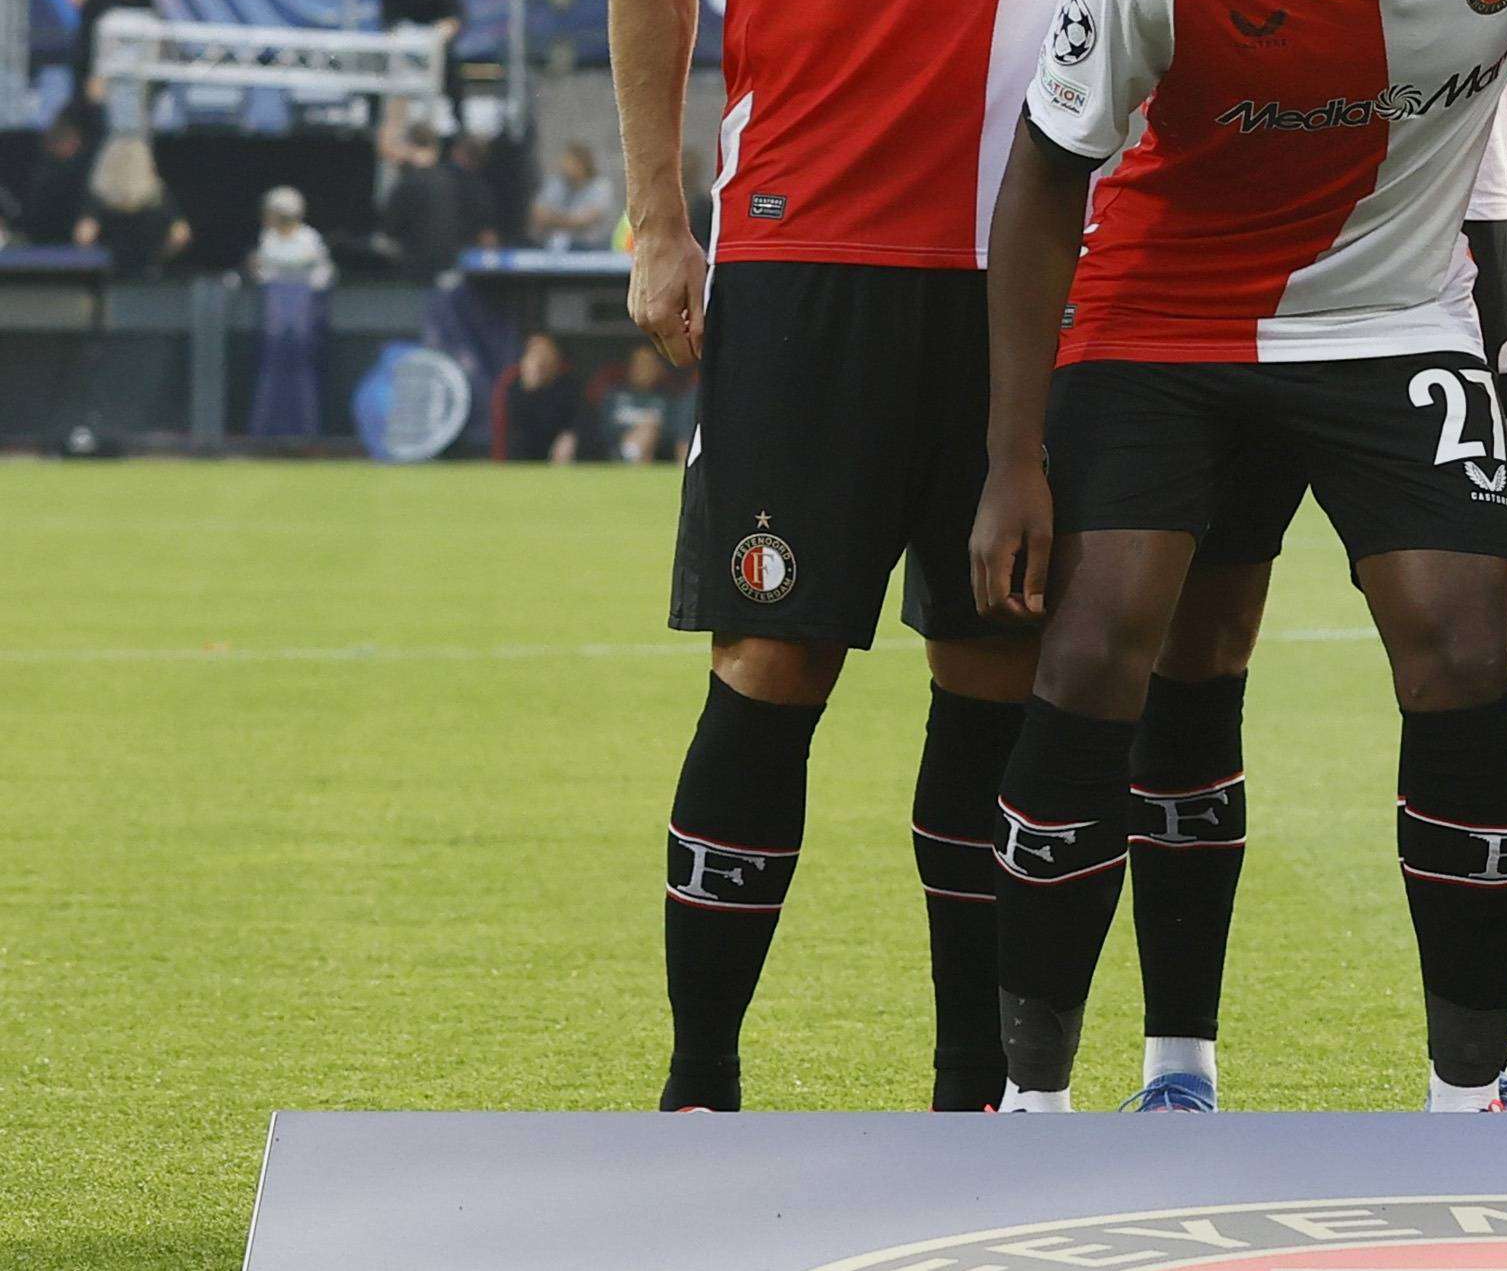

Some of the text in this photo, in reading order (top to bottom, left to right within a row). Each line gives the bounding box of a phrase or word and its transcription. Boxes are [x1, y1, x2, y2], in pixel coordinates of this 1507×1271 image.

[1216, 100, 1374, 134] Media
[1408, 368, 1507, 466] 27
[736, 537, 791, 560] FEYENOORD
[750, 552, 775, 584] F
[737, 576, 793, 601] ROTTERDAM
[1144, 789, 1229, 841] F
[1000, 813, 1077, 875] F
[678, 839, 765, 900] F
